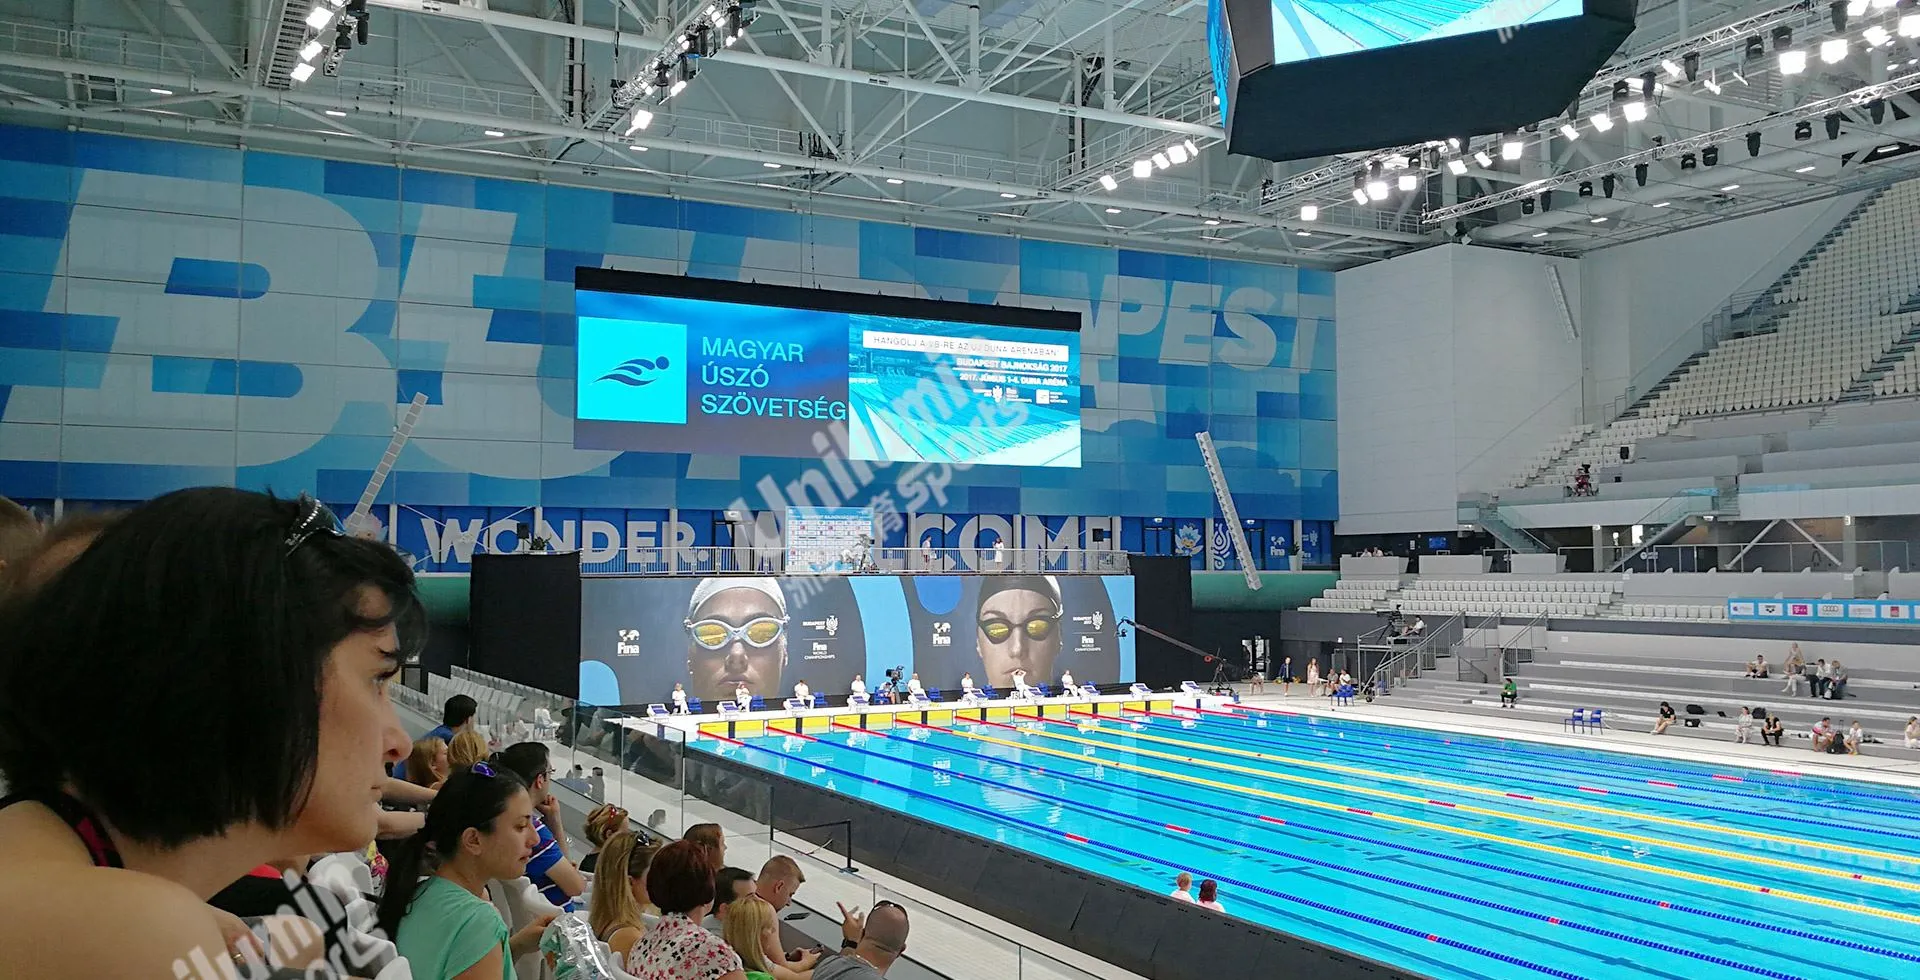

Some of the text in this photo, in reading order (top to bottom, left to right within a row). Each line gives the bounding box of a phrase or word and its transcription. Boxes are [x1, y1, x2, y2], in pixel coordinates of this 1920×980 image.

[702, 336, 804, 363] MAGYAR
[984, 343, 1008, 353] DUNA
[702, 362, 770, 389] ÚSZÓ
[956, 357, 1000, 369] BUDAPEST
[1049, 364, 1068, 373] 2017
[701, 391, 848, 422] SZÖVETSÉG
